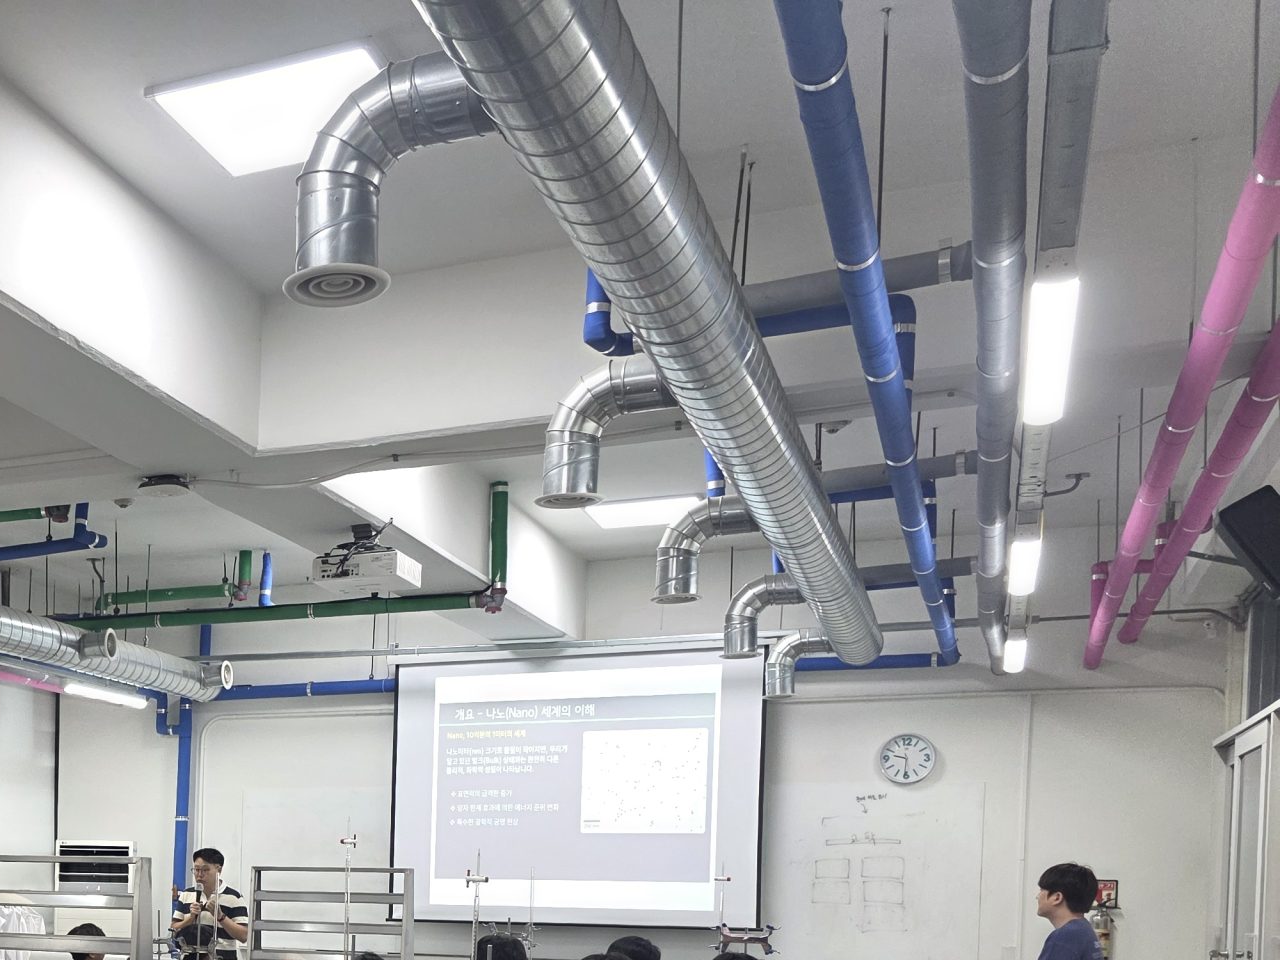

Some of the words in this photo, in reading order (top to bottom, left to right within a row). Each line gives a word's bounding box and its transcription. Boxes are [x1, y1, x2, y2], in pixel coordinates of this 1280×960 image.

[455, 709, 475, 720] 개요
[486, 706, 538, 720] 나노(Nano)
[541, 704, 571, 718] 세계의
[574, 703, 595, 717] 이해
[901, 738, 913, 746] 12
[882, 754, 890, 763] 9
[923, 753, 931, 762] 3
[902, 771, 910, 780] 6
